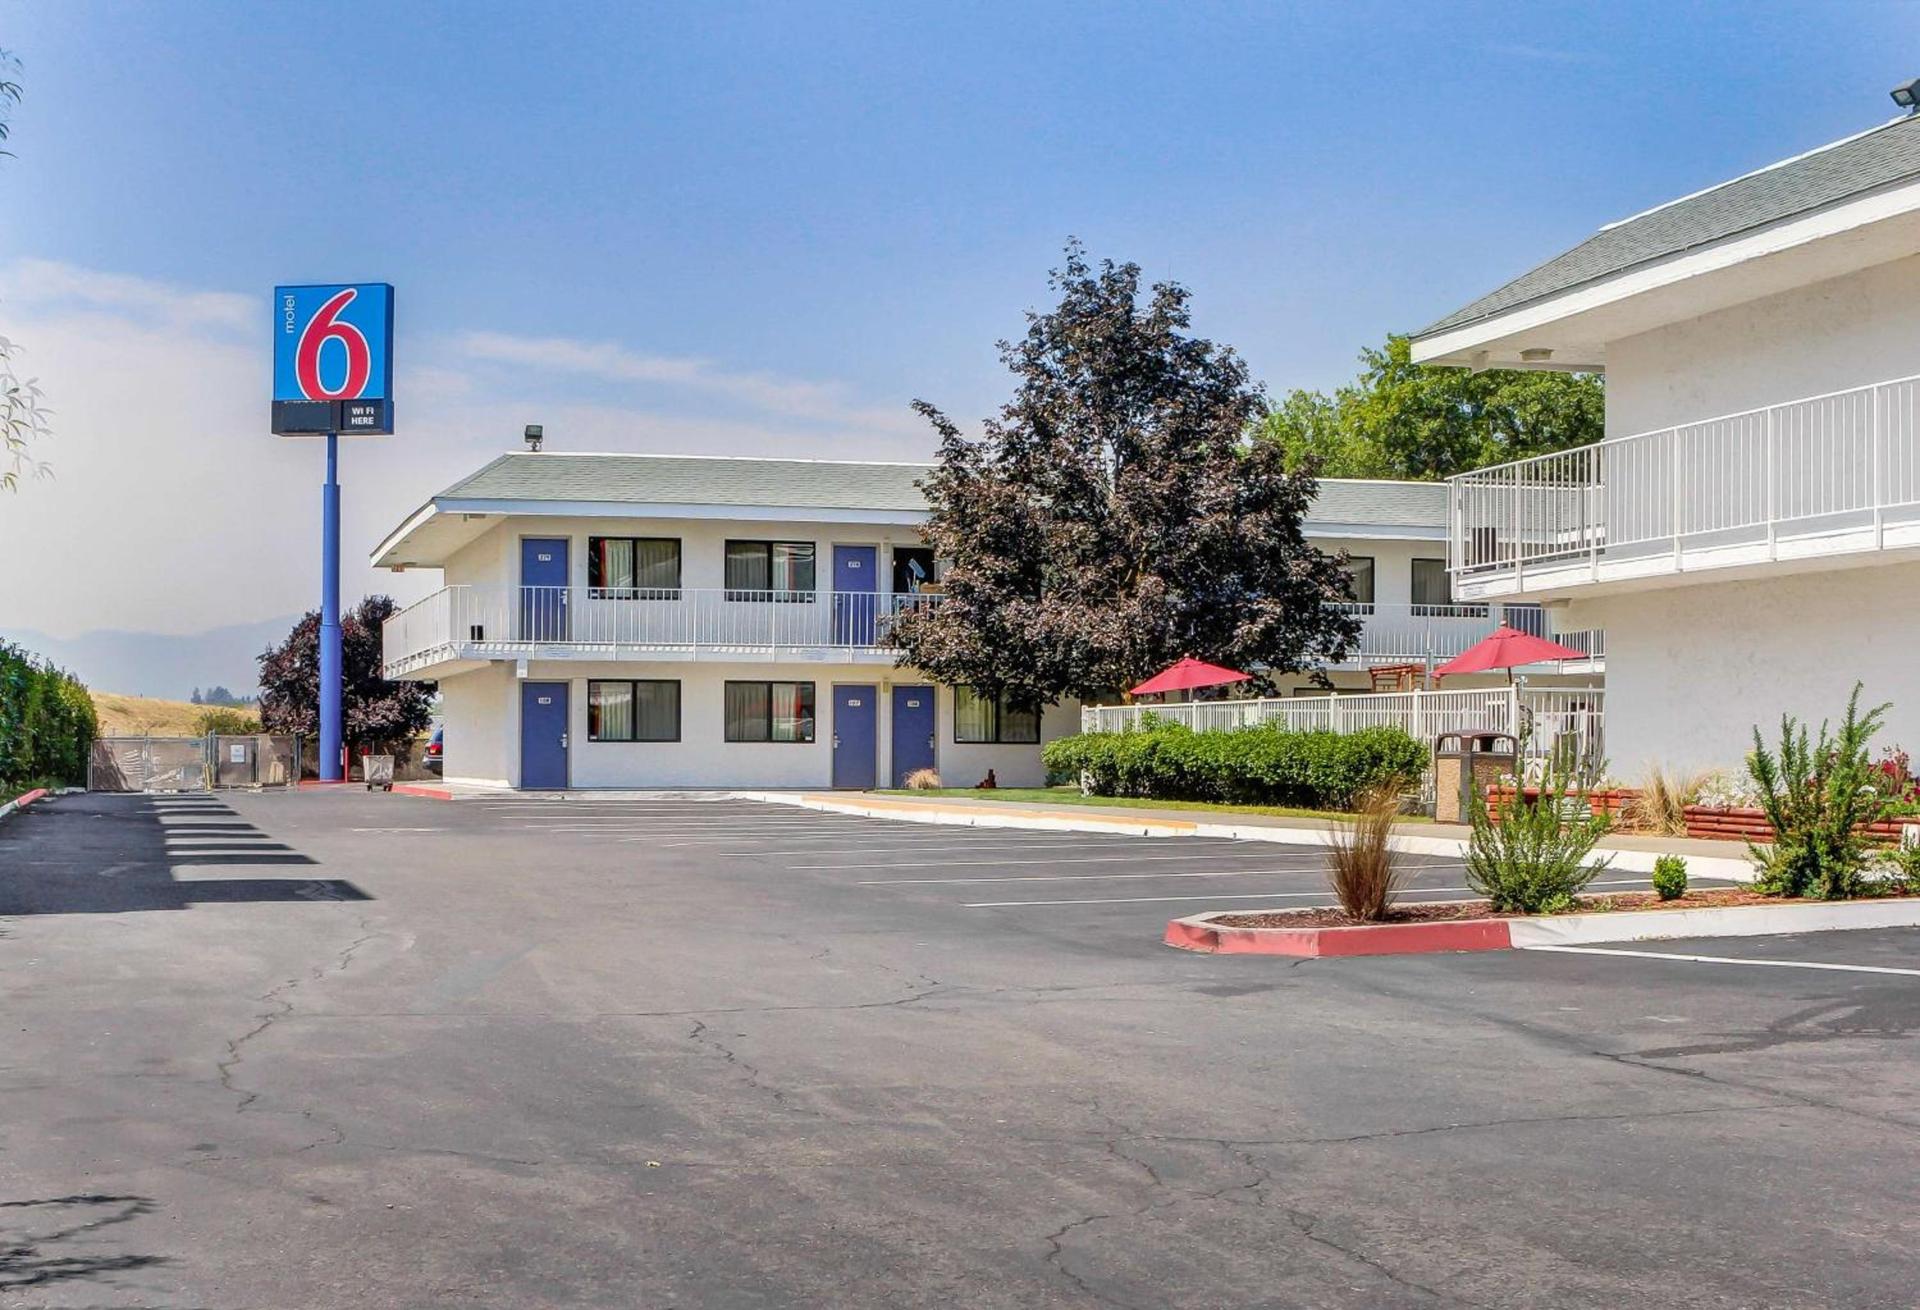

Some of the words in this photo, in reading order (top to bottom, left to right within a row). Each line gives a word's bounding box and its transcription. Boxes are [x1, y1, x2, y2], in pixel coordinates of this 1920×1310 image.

[284, 295, 296, 334] motel
[295, 287, 371, 401] 6
[351, 416, 375, 425] HERE
